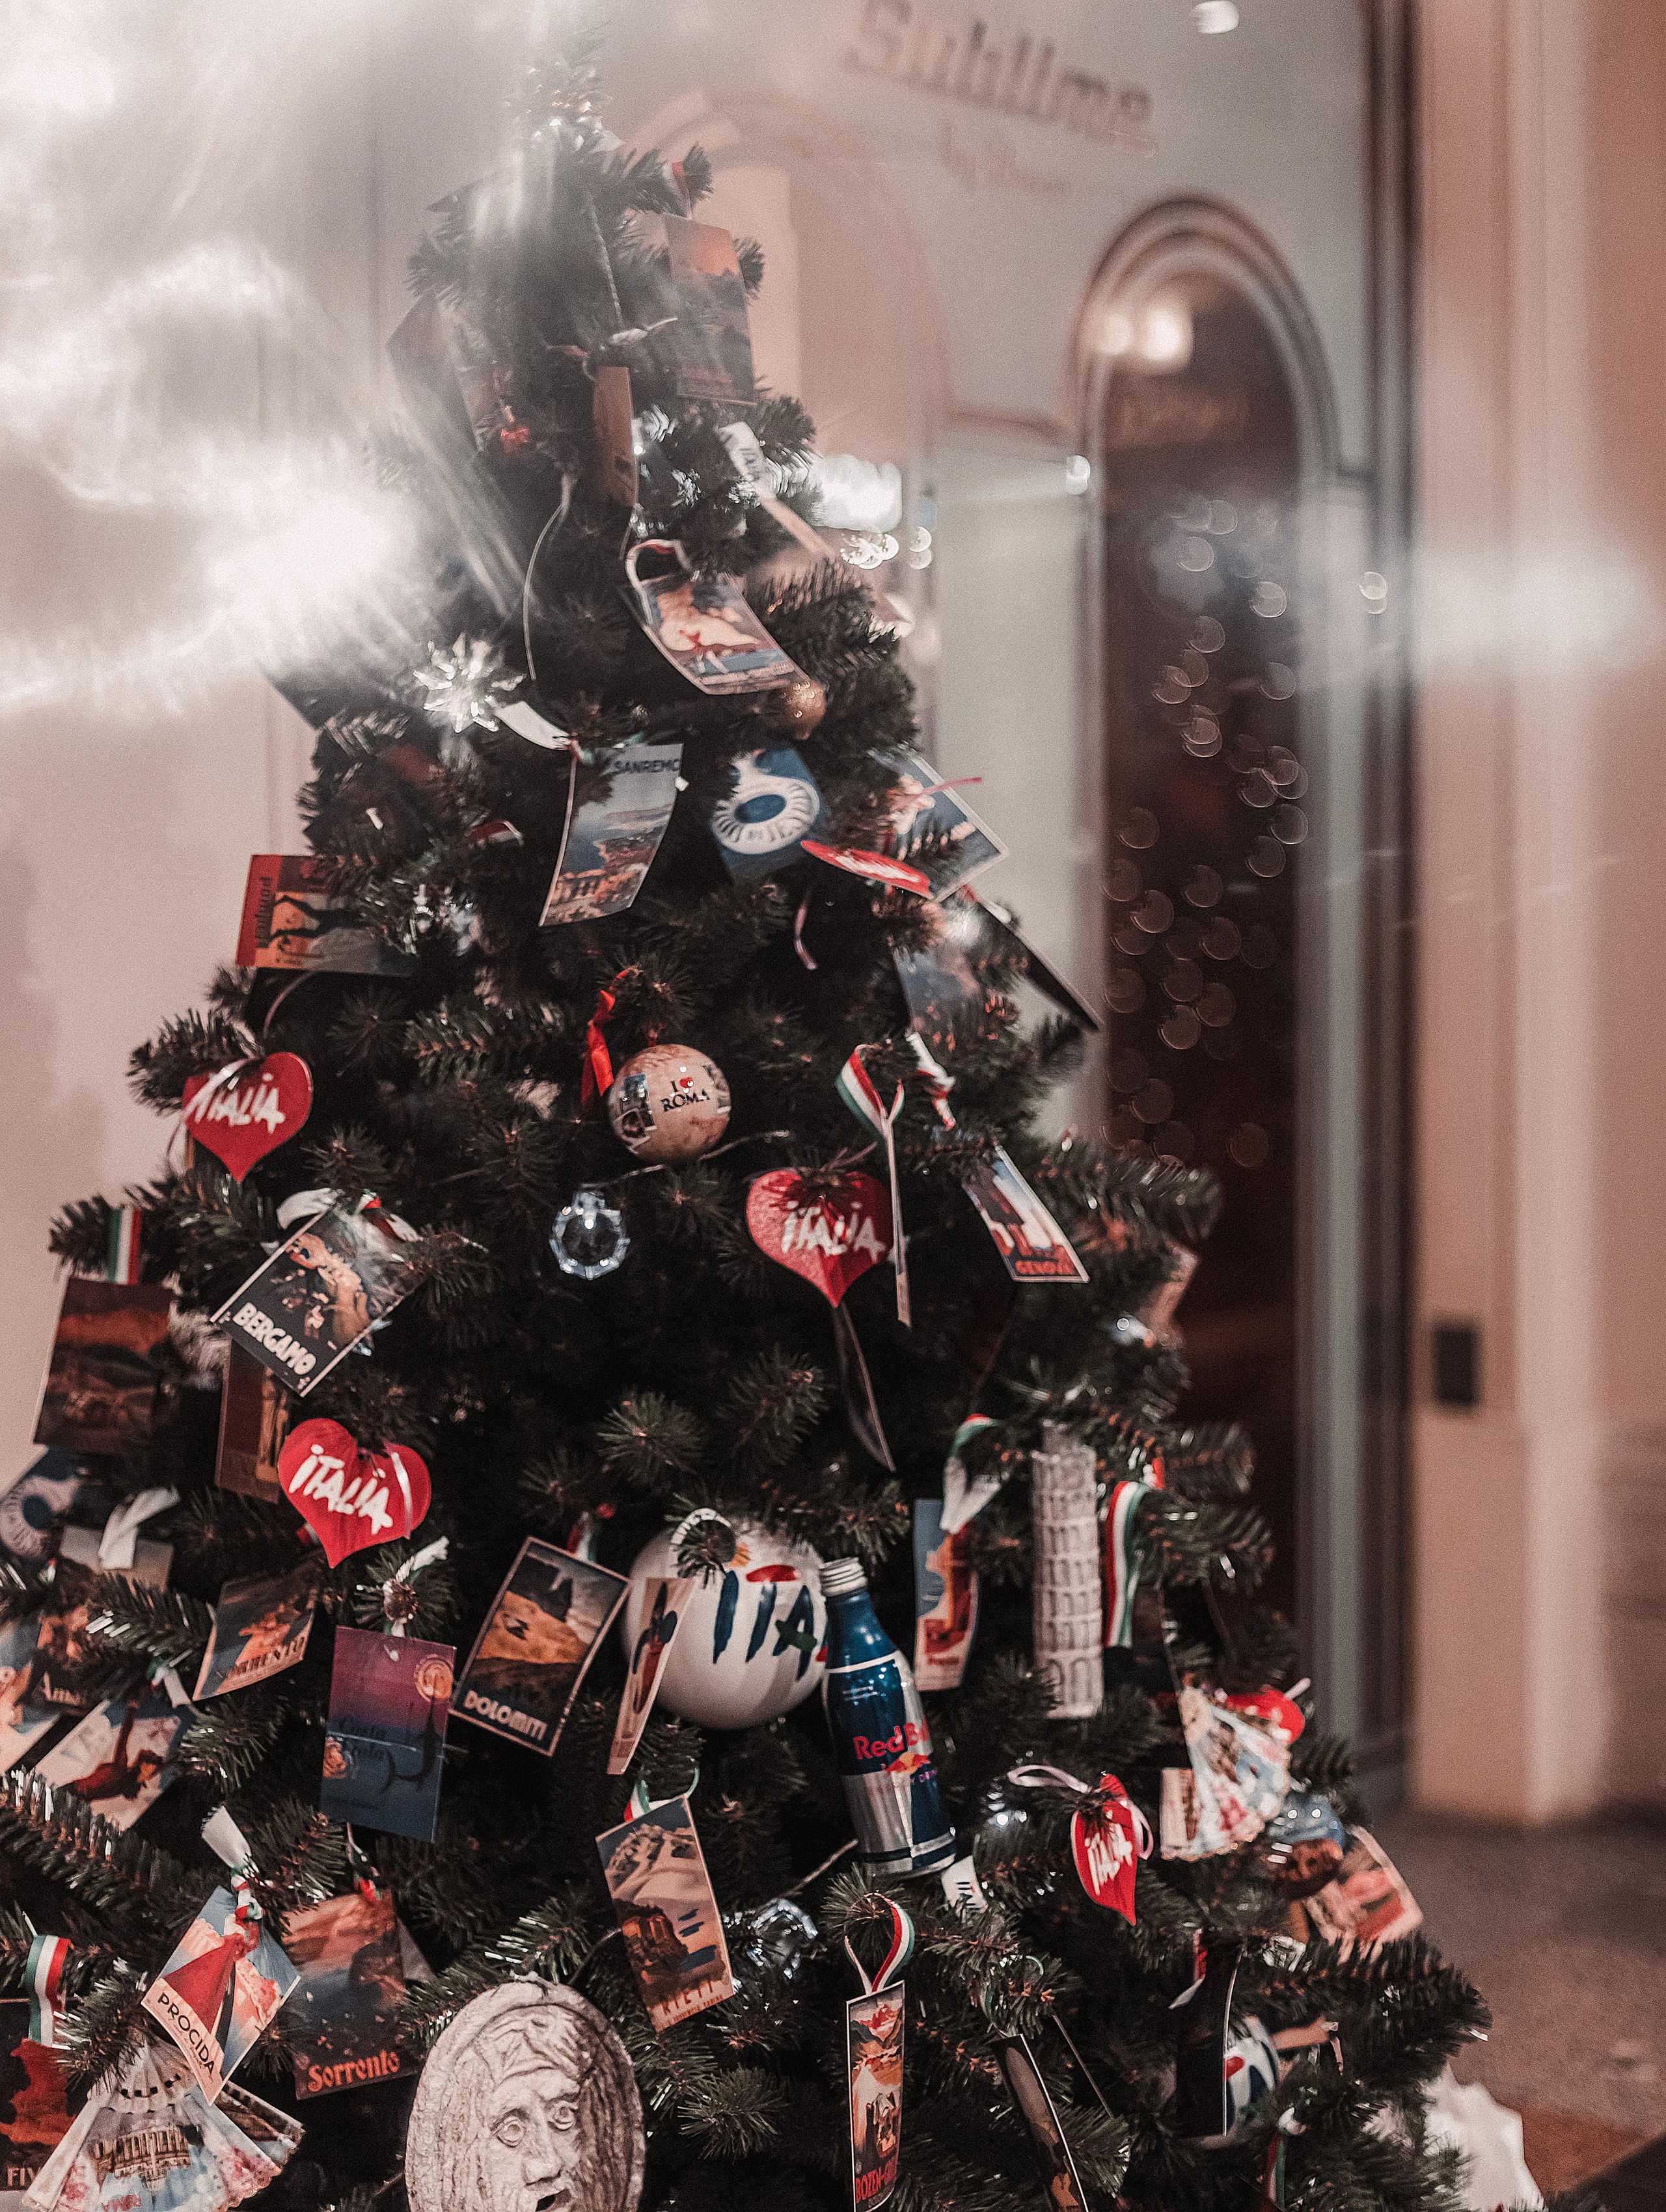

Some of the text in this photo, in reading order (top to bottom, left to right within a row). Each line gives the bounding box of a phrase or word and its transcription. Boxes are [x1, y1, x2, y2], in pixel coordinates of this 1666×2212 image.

[661, 1089, 710, 1112] ROMA
[670, 1080, 679, 1093] I
[233, 1302, 317, 1375] BERGAMO
[463, 1690, 548, 1741] DOLOMITI
[853, 1725, 904, 1760] Red
[158, 1993, 216, 2075] PROCIDA
[307, 2049, 401, 2092] Sorrento
